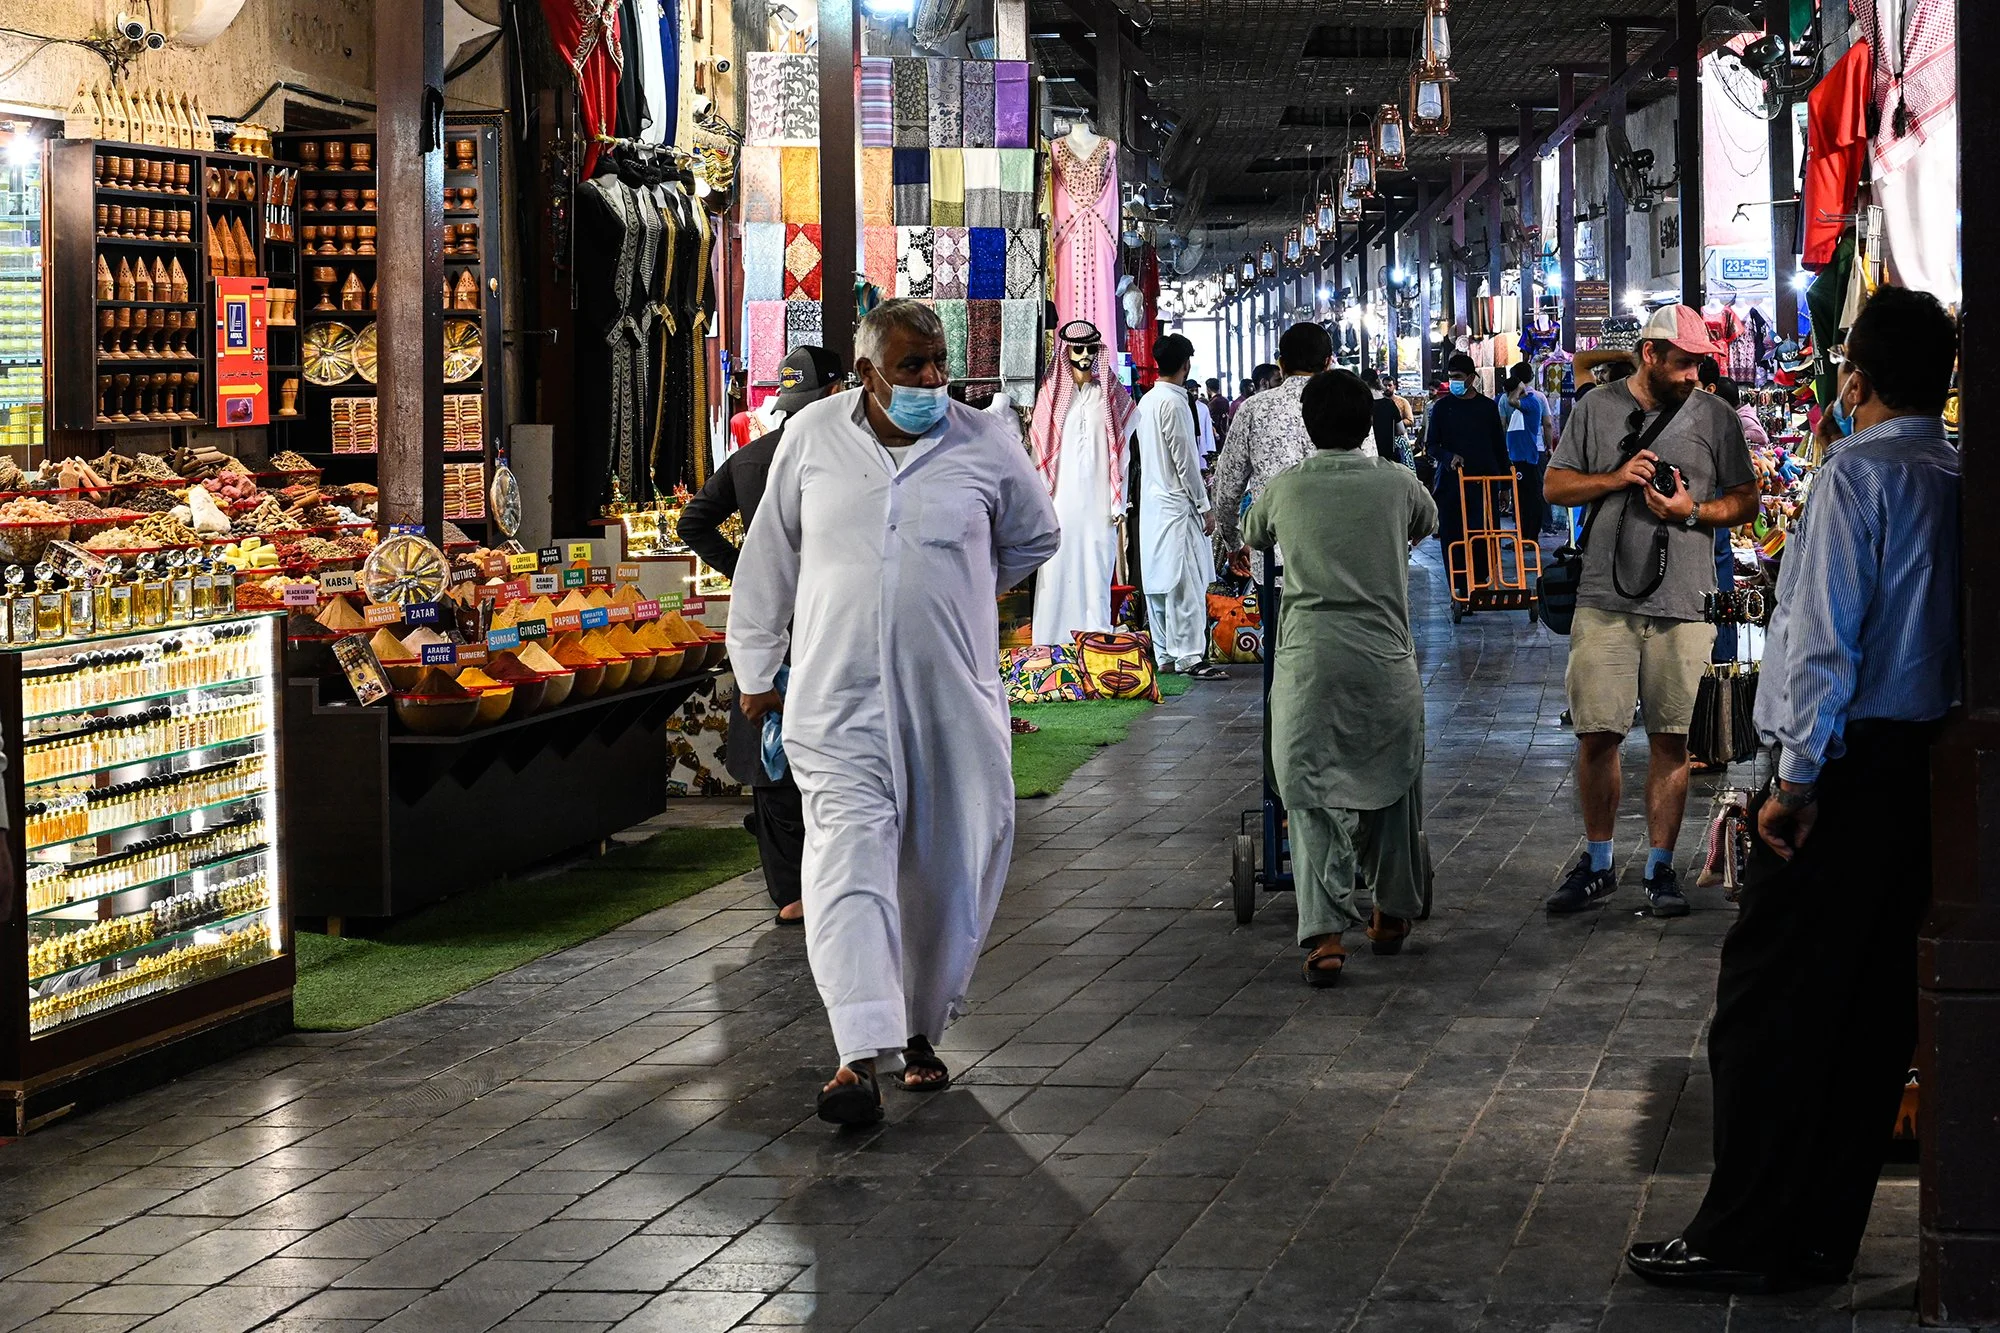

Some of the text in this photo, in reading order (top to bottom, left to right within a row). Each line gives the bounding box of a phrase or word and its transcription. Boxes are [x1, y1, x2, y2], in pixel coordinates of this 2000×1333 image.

[1726, 260, 1740, 272] 23
[452, 568, 476, 581] NUTMEG
[618, 568, 638, 576] CUMIN
[326, 577, 352, 587] KABSA
[368, 606, 396, 615] RUSSELL
[411, 608, 435, 619] ZATAR
[369, 614, 395, 623] HANOUT
[555, 616, 579, 626] PAPRIKA
[520, 625, 545, 636] GINGER
[491, 634, 516, 645] SUMAC
[427, 654, 449, 662] COFFEE
[459, 651, 485, 659] TURMERIC
